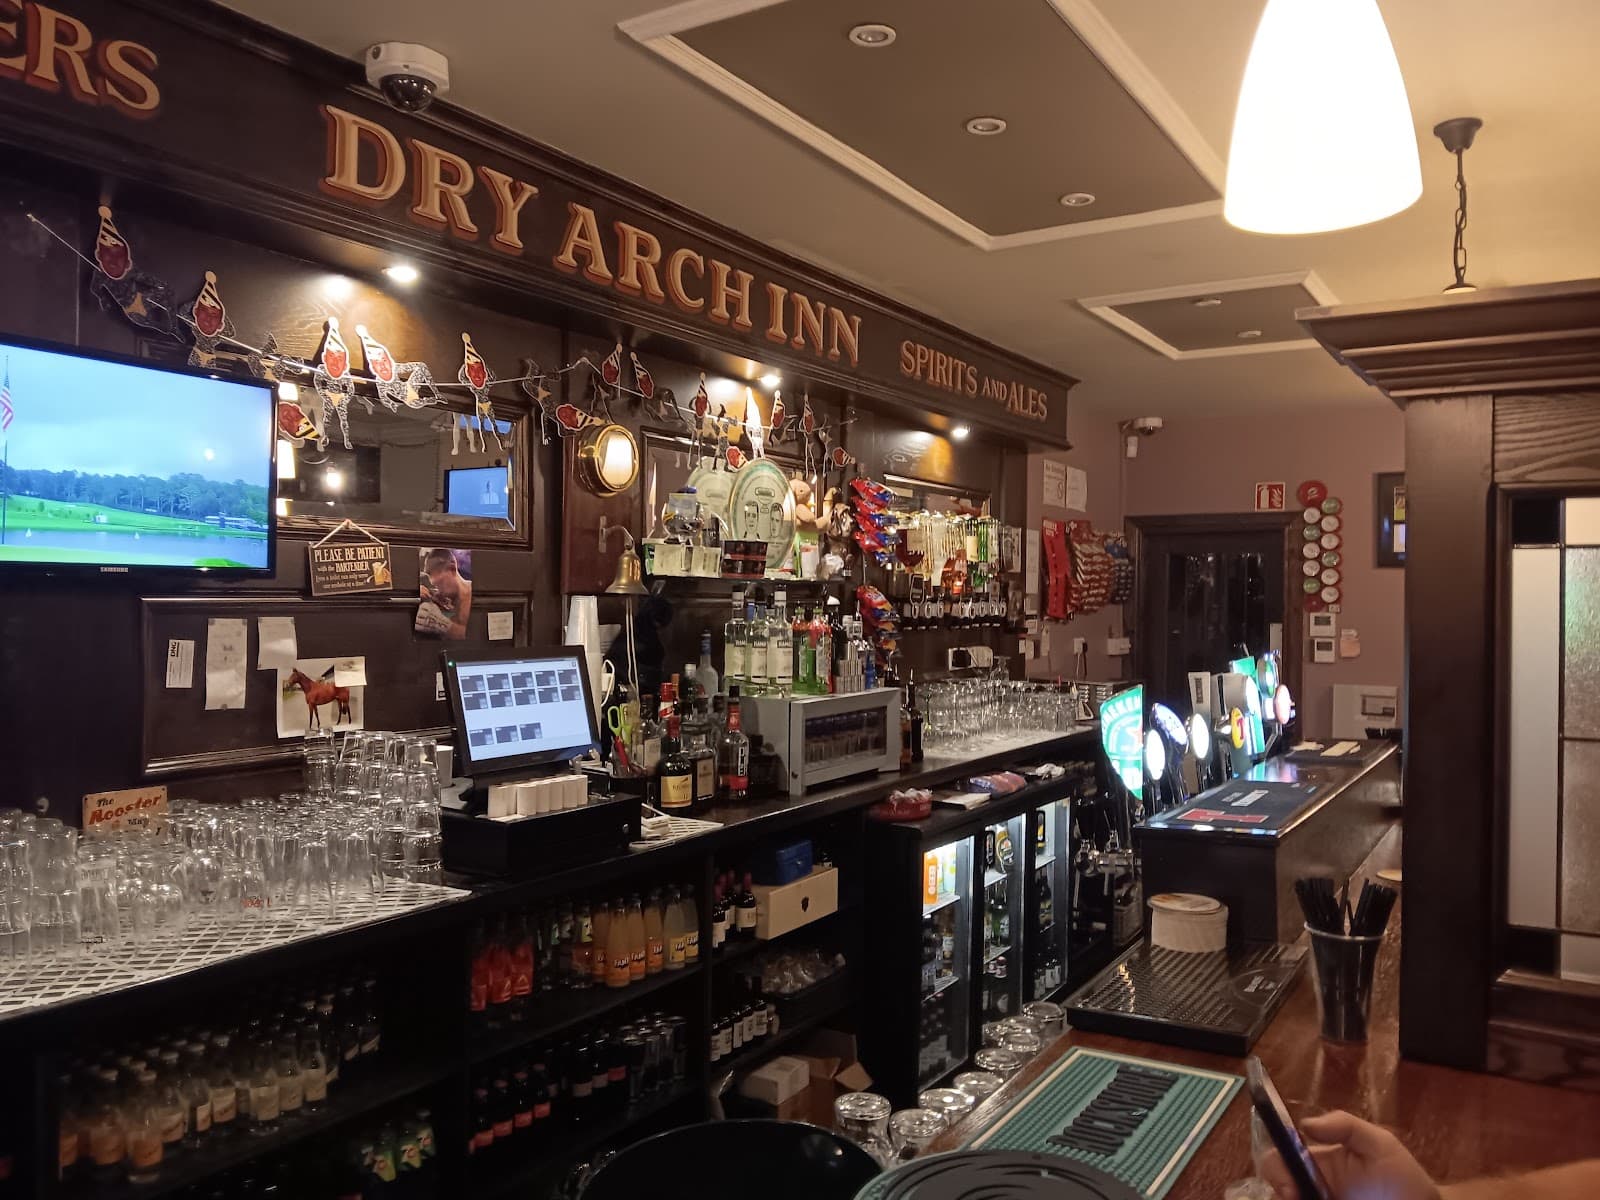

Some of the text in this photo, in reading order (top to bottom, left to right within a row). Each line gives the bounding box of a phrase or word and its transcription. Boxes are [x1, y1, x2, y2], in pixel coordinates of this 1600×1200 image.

[319, 105, 862, 368] DRY ARCH INN
[901, 340, 1048, 421] SPIRITS AND ALES
[314, 546, 385, 562] PLEASE BE PATIENT
[335, 561, 369, 572] BARTENDER
[87, 794, 162, 825] Rooster
[96, 797, 114, 807] The
